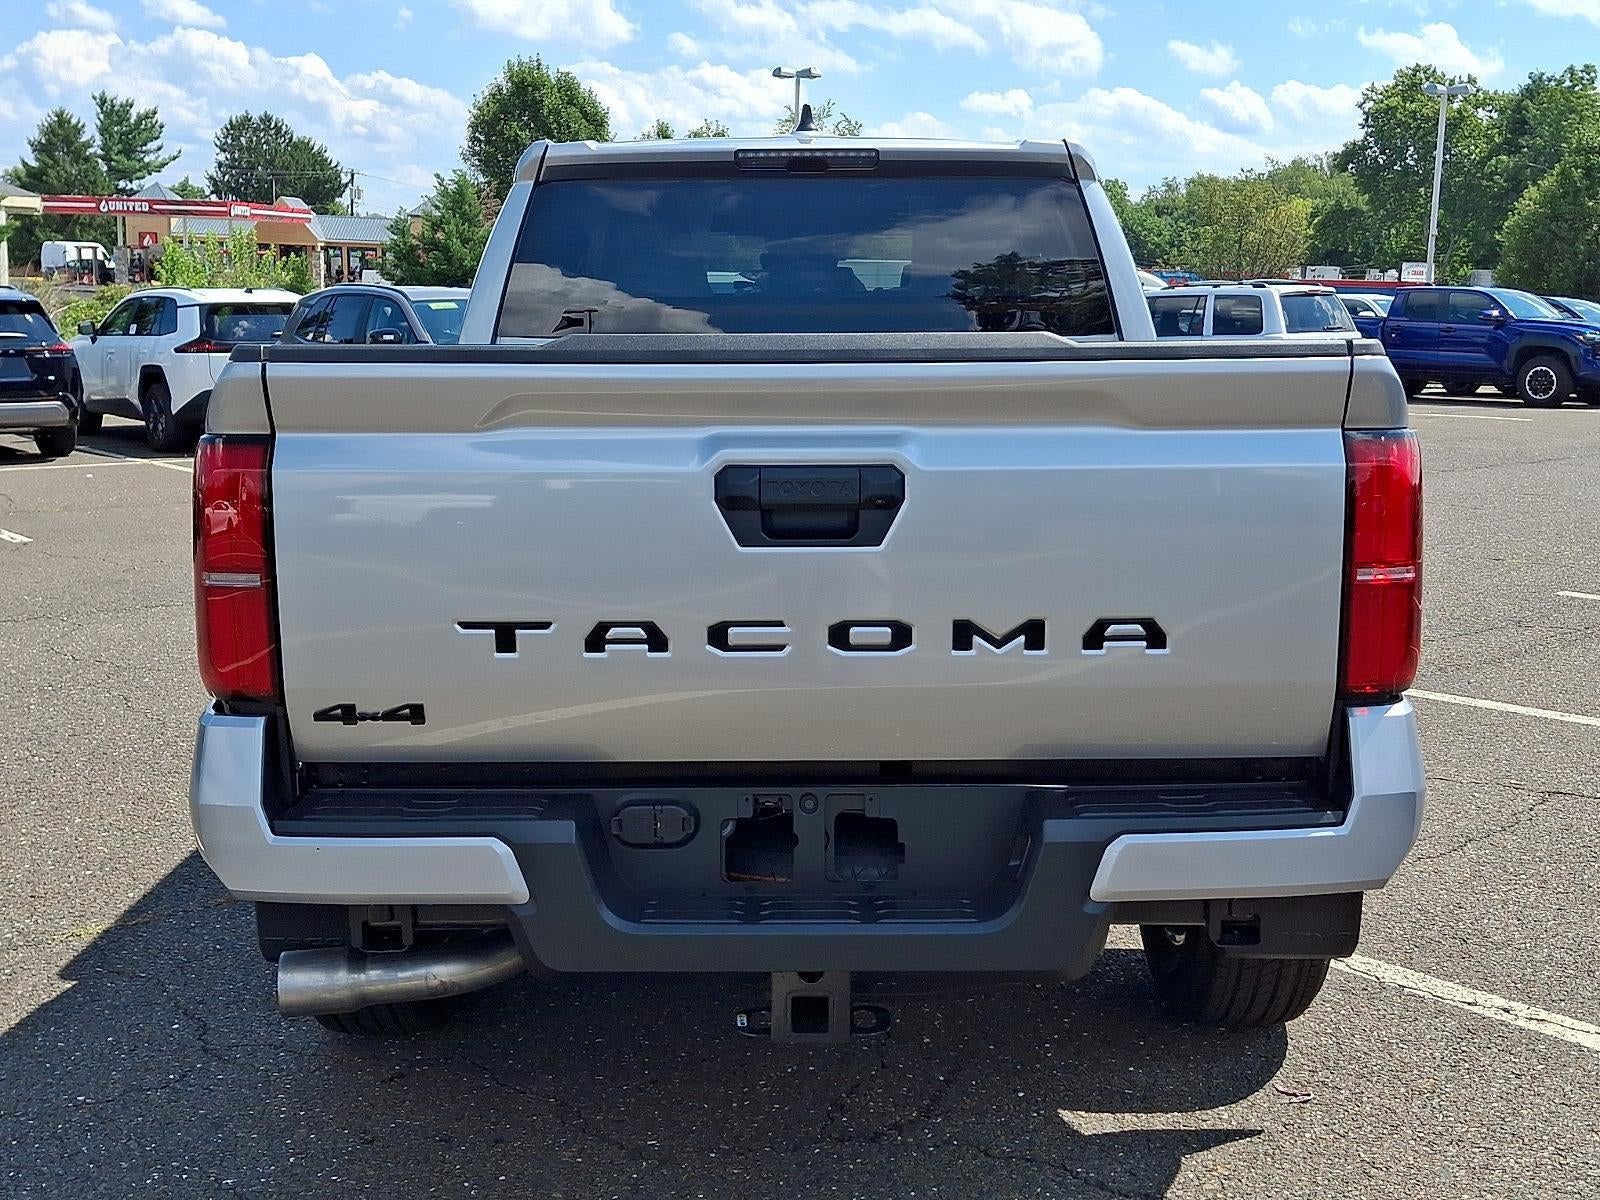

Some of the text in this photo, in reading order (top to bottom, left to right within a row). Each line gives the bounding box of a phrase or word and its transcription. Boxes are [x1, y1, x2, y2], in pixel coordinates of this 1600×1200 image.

[109, 201, 150, 212] UNITED
[767, 480, 856, 497] TOYOTA
[454, 617, 1171, 658] TACOMA
